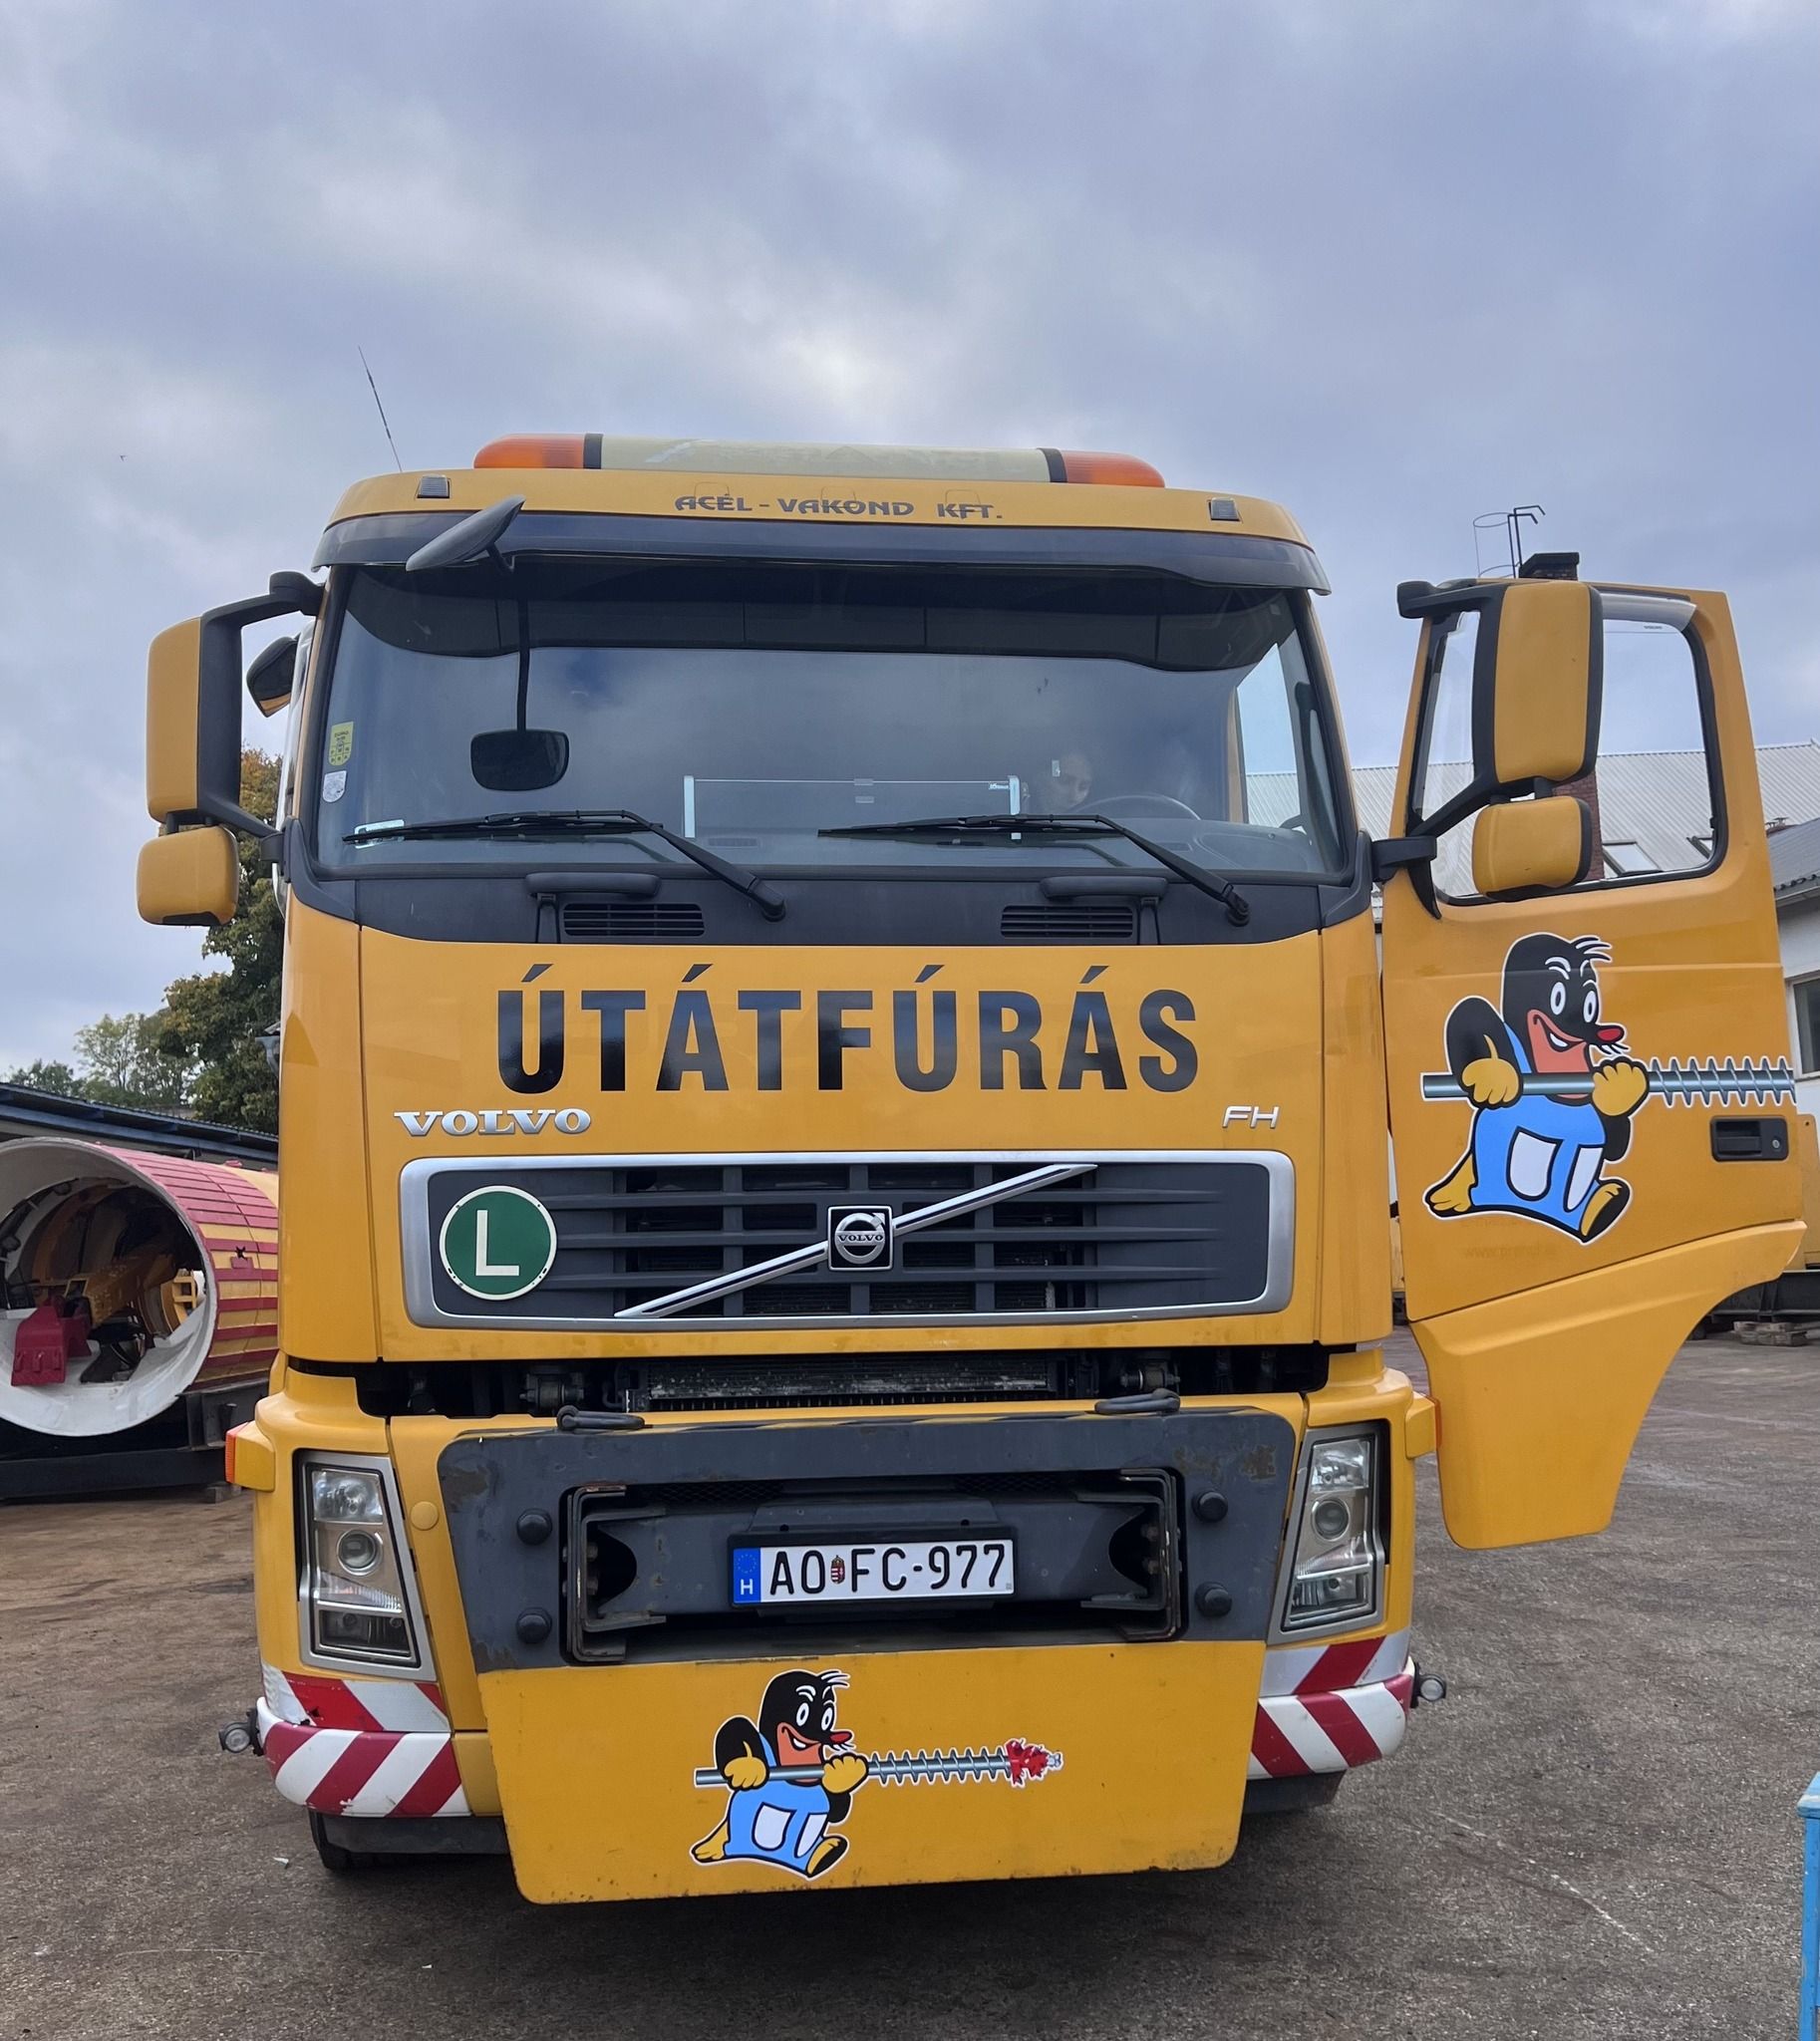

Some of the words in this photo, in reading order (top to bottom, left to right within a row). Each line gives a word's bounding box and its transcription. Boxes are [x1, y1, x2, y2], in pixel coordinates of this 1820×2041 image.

[937, 502, 1003, 519] KFT.
[497, 963, 1198, 1095] ÚTÁTFÚRÁS
[394, 1107, 592, 1137] VOLVO
[1222, 1105, 1280, 1129] FH
[475, 1209, 520, 1277] L
[769, 1550, 826, 1596] AO
[851, 1544, 1006, 1593] FC-977
[740, 1579, 754, 1596] H
